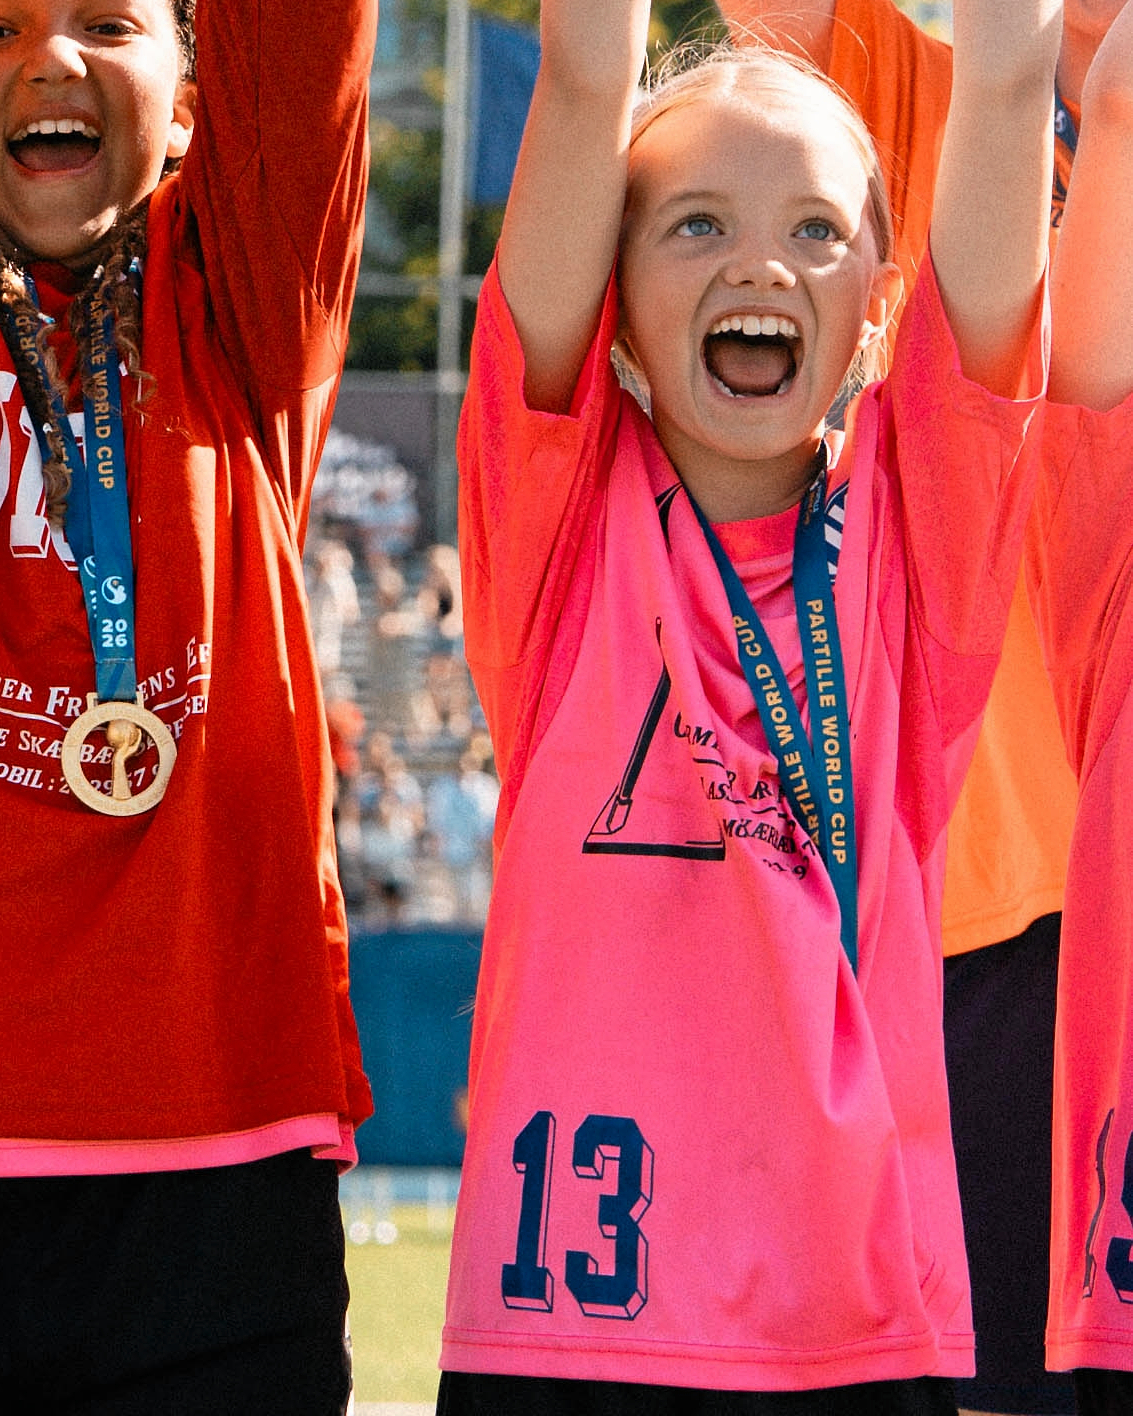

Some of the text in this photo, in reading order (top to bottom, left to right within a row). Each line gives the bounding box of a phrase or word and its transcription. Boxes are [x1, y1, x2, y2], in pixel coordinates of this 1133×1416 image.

[92, 369, 111, 439] WORLD
[96, 445, 115, 490] CUP
[101, 618, 128, 633] 20
[101, 633, 128, 648] 26
[732, 615, 763, 657] CUP
[755, 663, 795, 747] WORLD
[807, 599, 848, 865] PARTILLE WORLD CUP
[500, 1110, 655, 1322] 13
